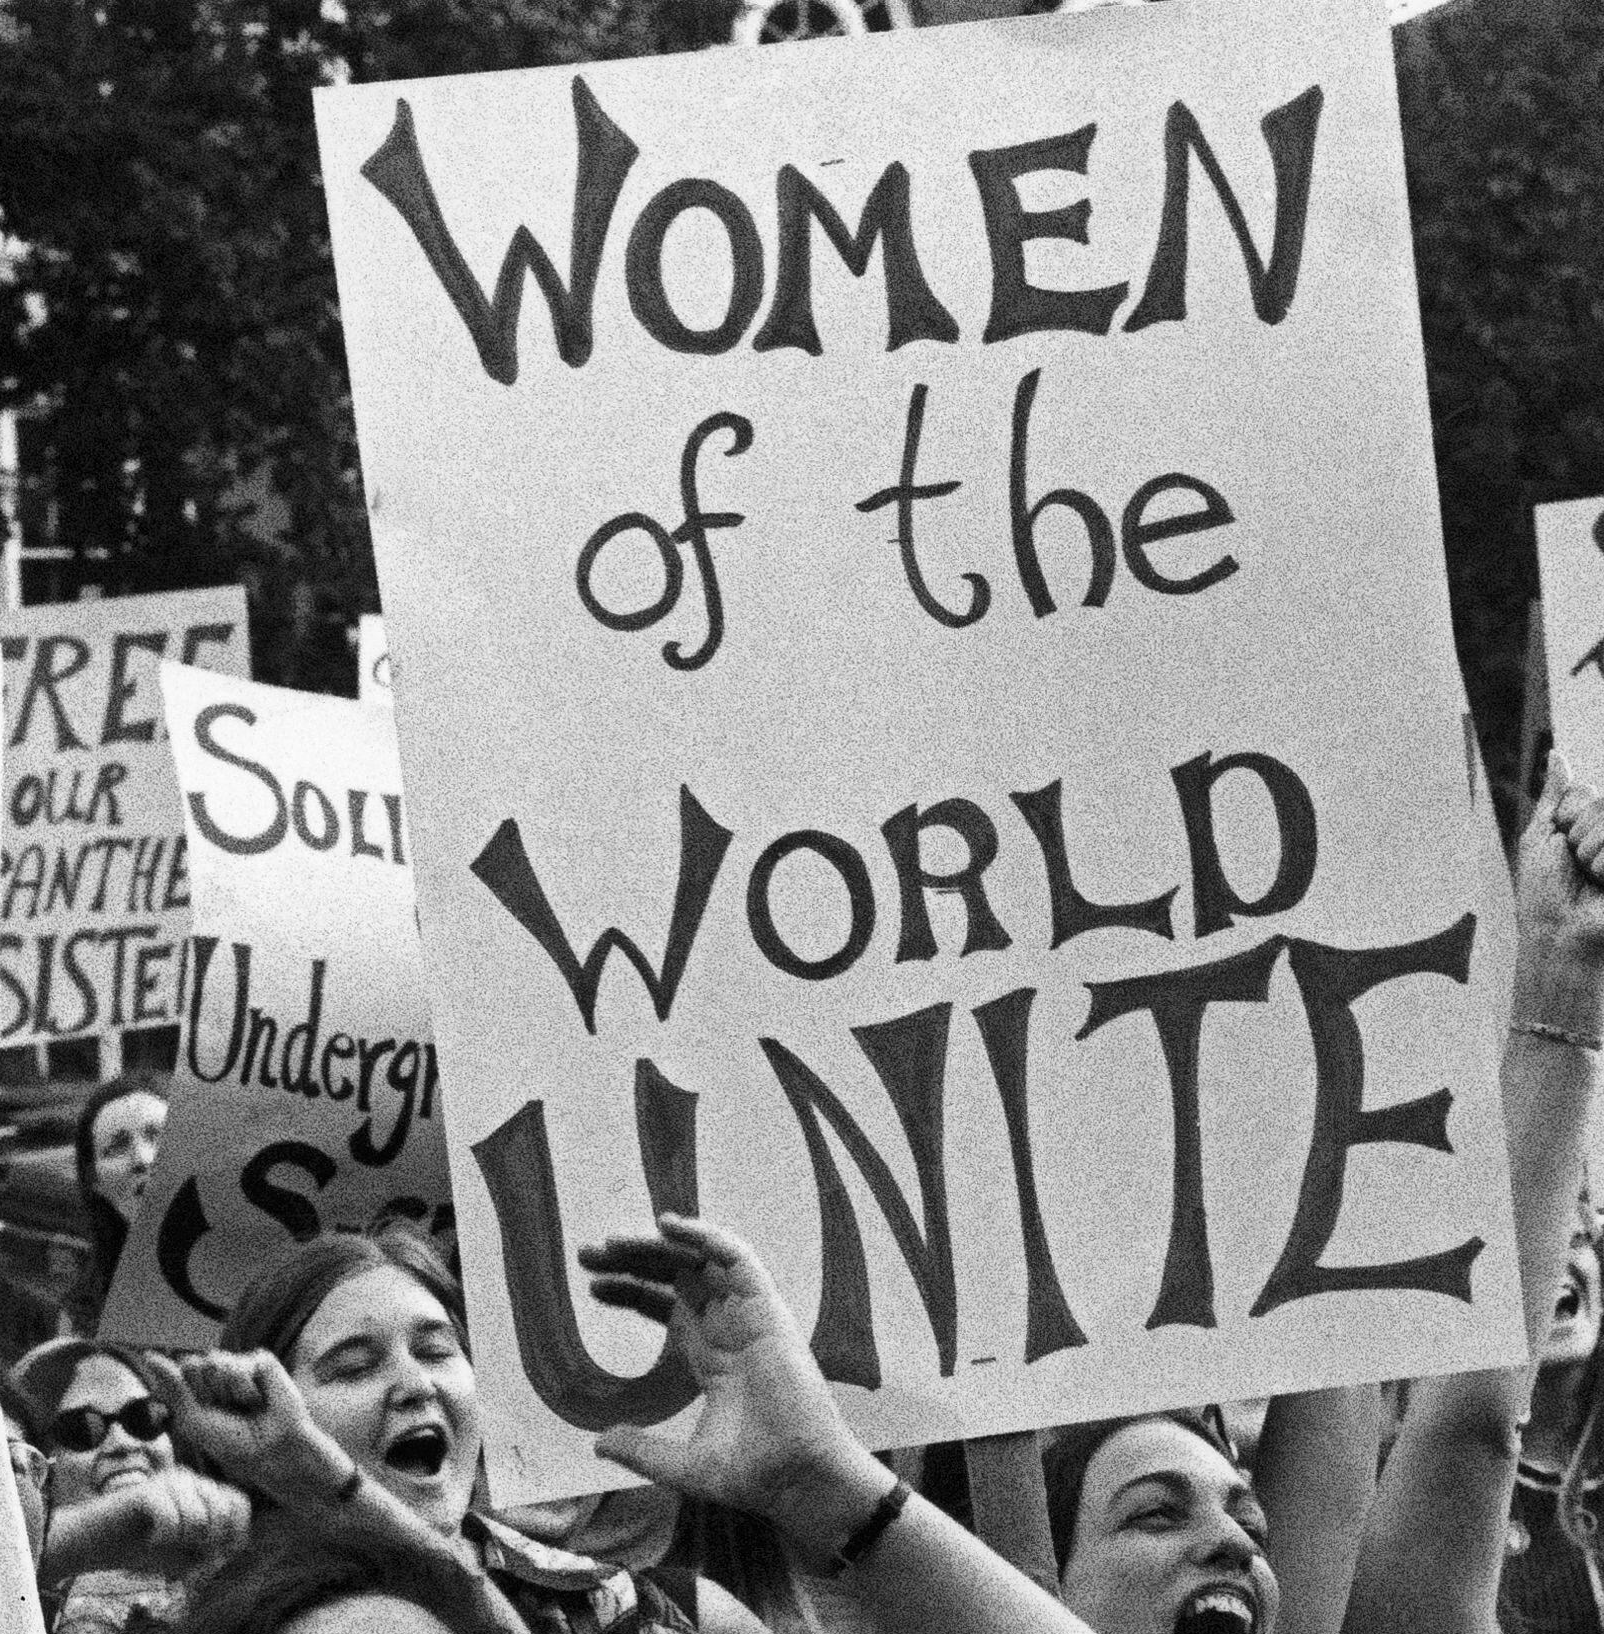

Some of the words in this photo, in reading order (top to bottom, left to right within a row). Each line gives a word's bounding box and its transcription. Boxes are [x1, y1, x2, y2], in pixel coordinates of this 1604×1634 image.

[362, 74, 1323, 385] WOMEN
[576, 410, 753, 672] of
[854, 368, 1241, 630] the
[470, 750, 1318, 1036] WORLD
[470, 912, 1484, 1435] UNITE
